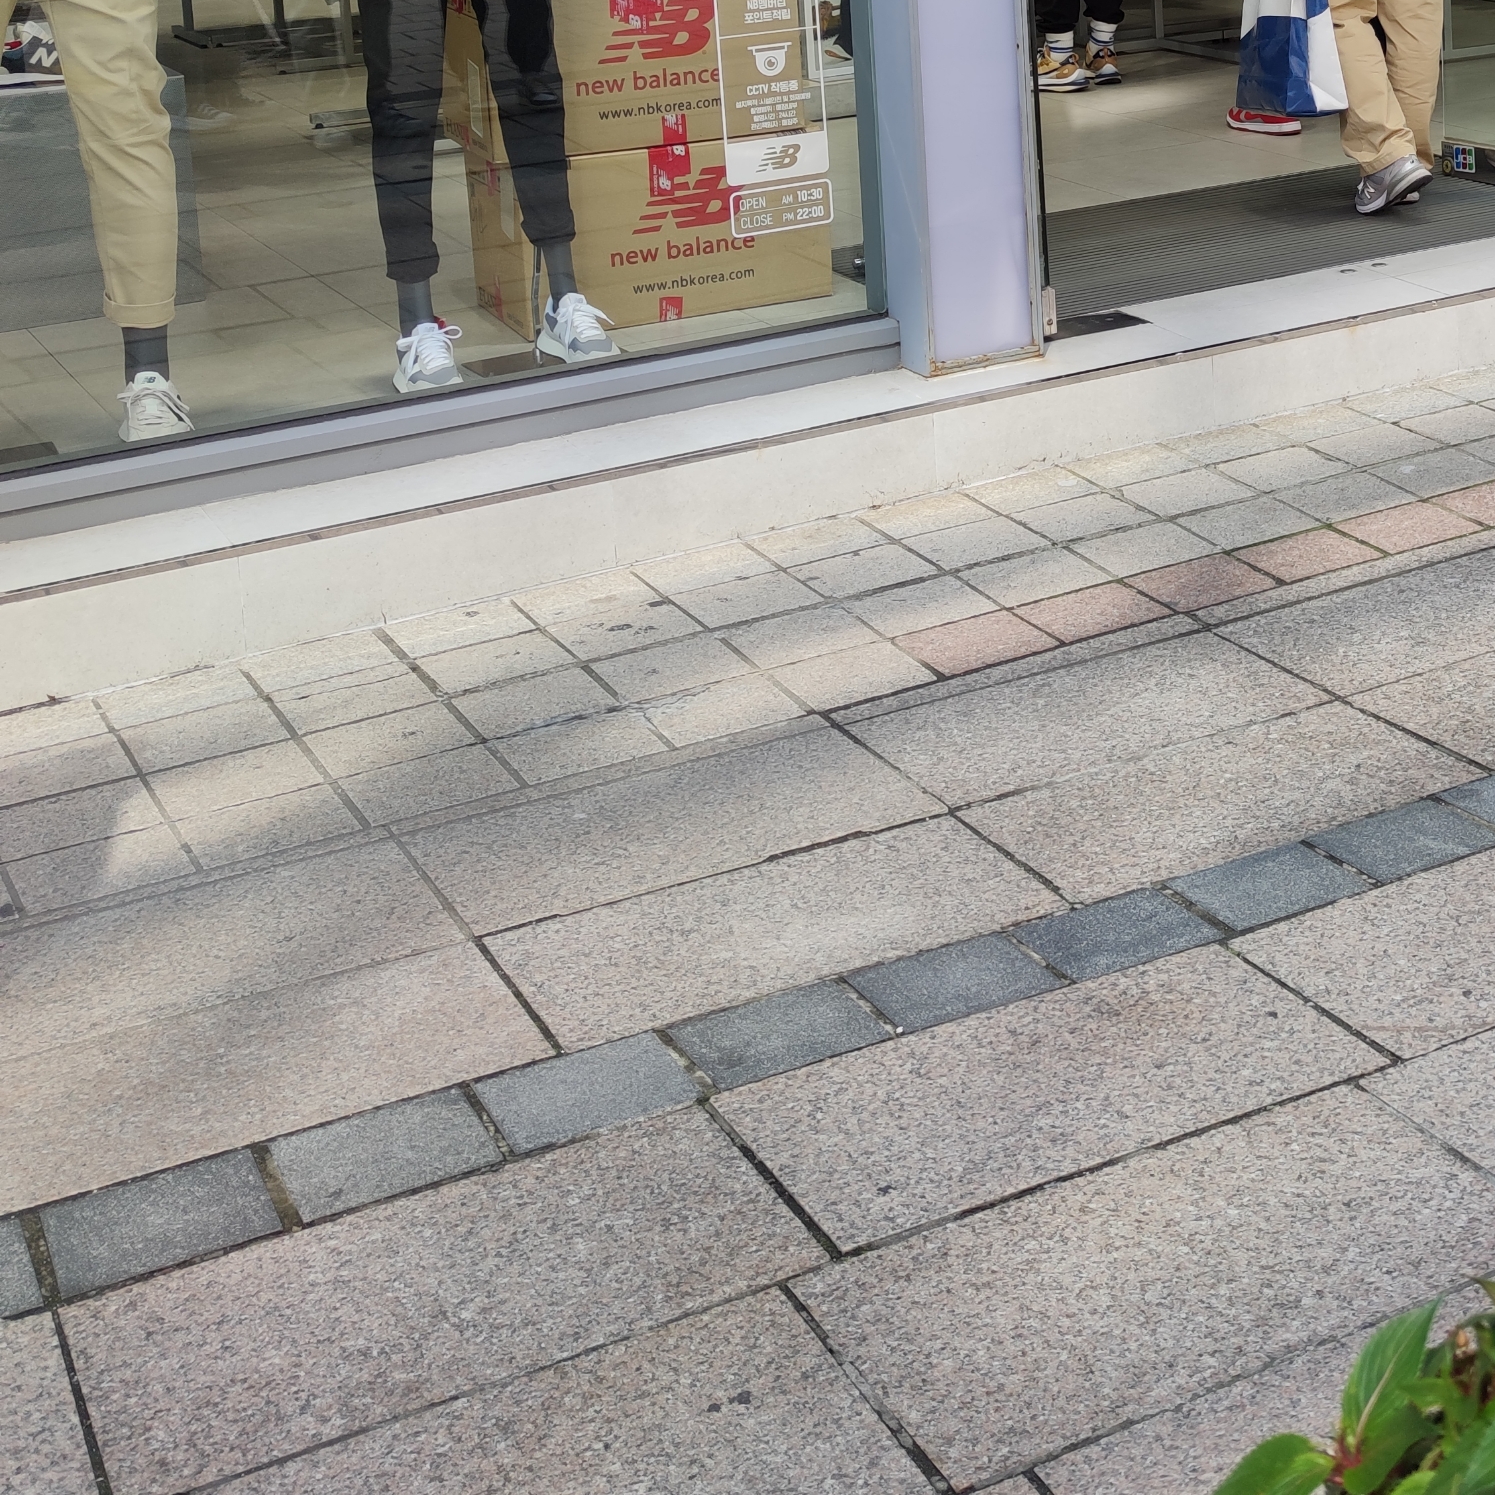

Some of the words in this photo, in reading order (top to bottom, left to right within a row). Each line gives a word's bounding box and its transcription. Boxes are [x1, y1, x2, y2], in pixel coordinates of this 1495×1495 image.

[744, 8, 791, 23] 포인트적립
[576, 77, 625, 97] new
[632, 67, 719, 91] balance
[746, 83, 768, 95] CCTV
[770, 79, 798, 92] 작동중
[599, 97, 722, 120] www.nbkorea.com
[740, 196, 766, 211] OPEN
[782, 194, 793, 204] AM
[797, 187, 823, 202] 10:30
[741, 213, 773, 229] CLOSE
[783, 212, 794, 222] PM
[797, 205, 824, 220] 22:00
[610, 246, 659, 267] new
[666, 236, 756, 259] balance
[633, 267, 755, 294] www.nbkorea.com
